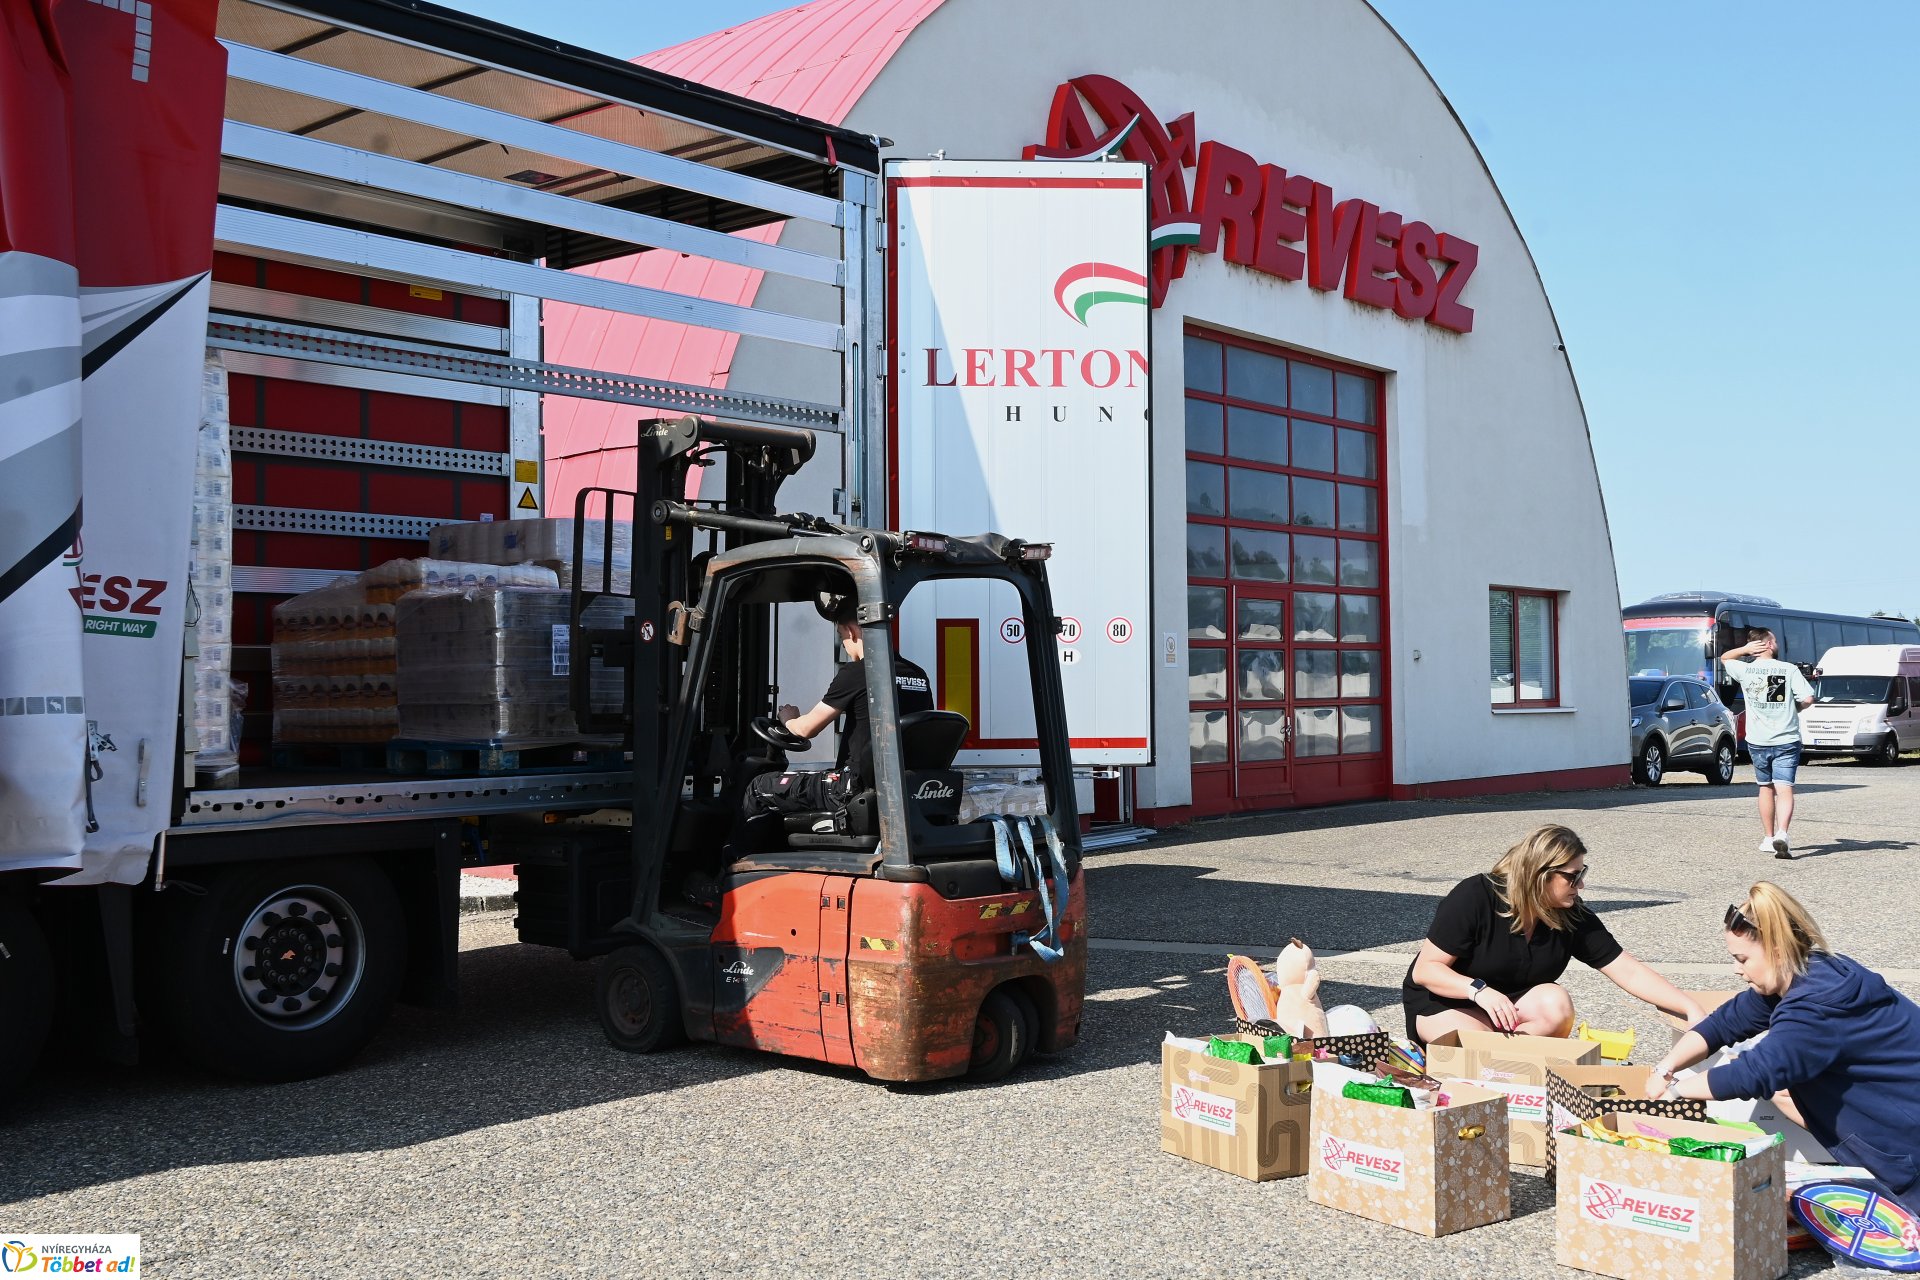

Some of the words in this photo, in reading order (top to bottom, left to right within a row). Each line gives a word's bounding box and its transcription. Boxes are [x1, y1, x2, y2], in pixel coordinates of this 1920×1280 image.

[1190, 140, 1478, 333] REVESZ
[1005, 405, 1150, 423] HUN
[640, 423, 669, 438] Linde
[85, 619, 120, 632] RIGHT
[122, 622, 148, 634] WAY
[1006, 624, 1020, 637] 50
[1062, 624, 1076, 637] 70
[1112, 624, 1126, 637] 80
[1063, 650, 1073, 662] H
[895, 676, 927, 687] REVESZ
[911, 779, 954, 799] Linde
[722, 960, 755, 976] Linde
[1502, 1092, 1545, 1107] VESZ
[1193, 1099, 1234, 1120] REVESZ
[1346, 1150, 1402, 1174] REVESZ
[1622, 1197, 1696, 1223] REVESZ
